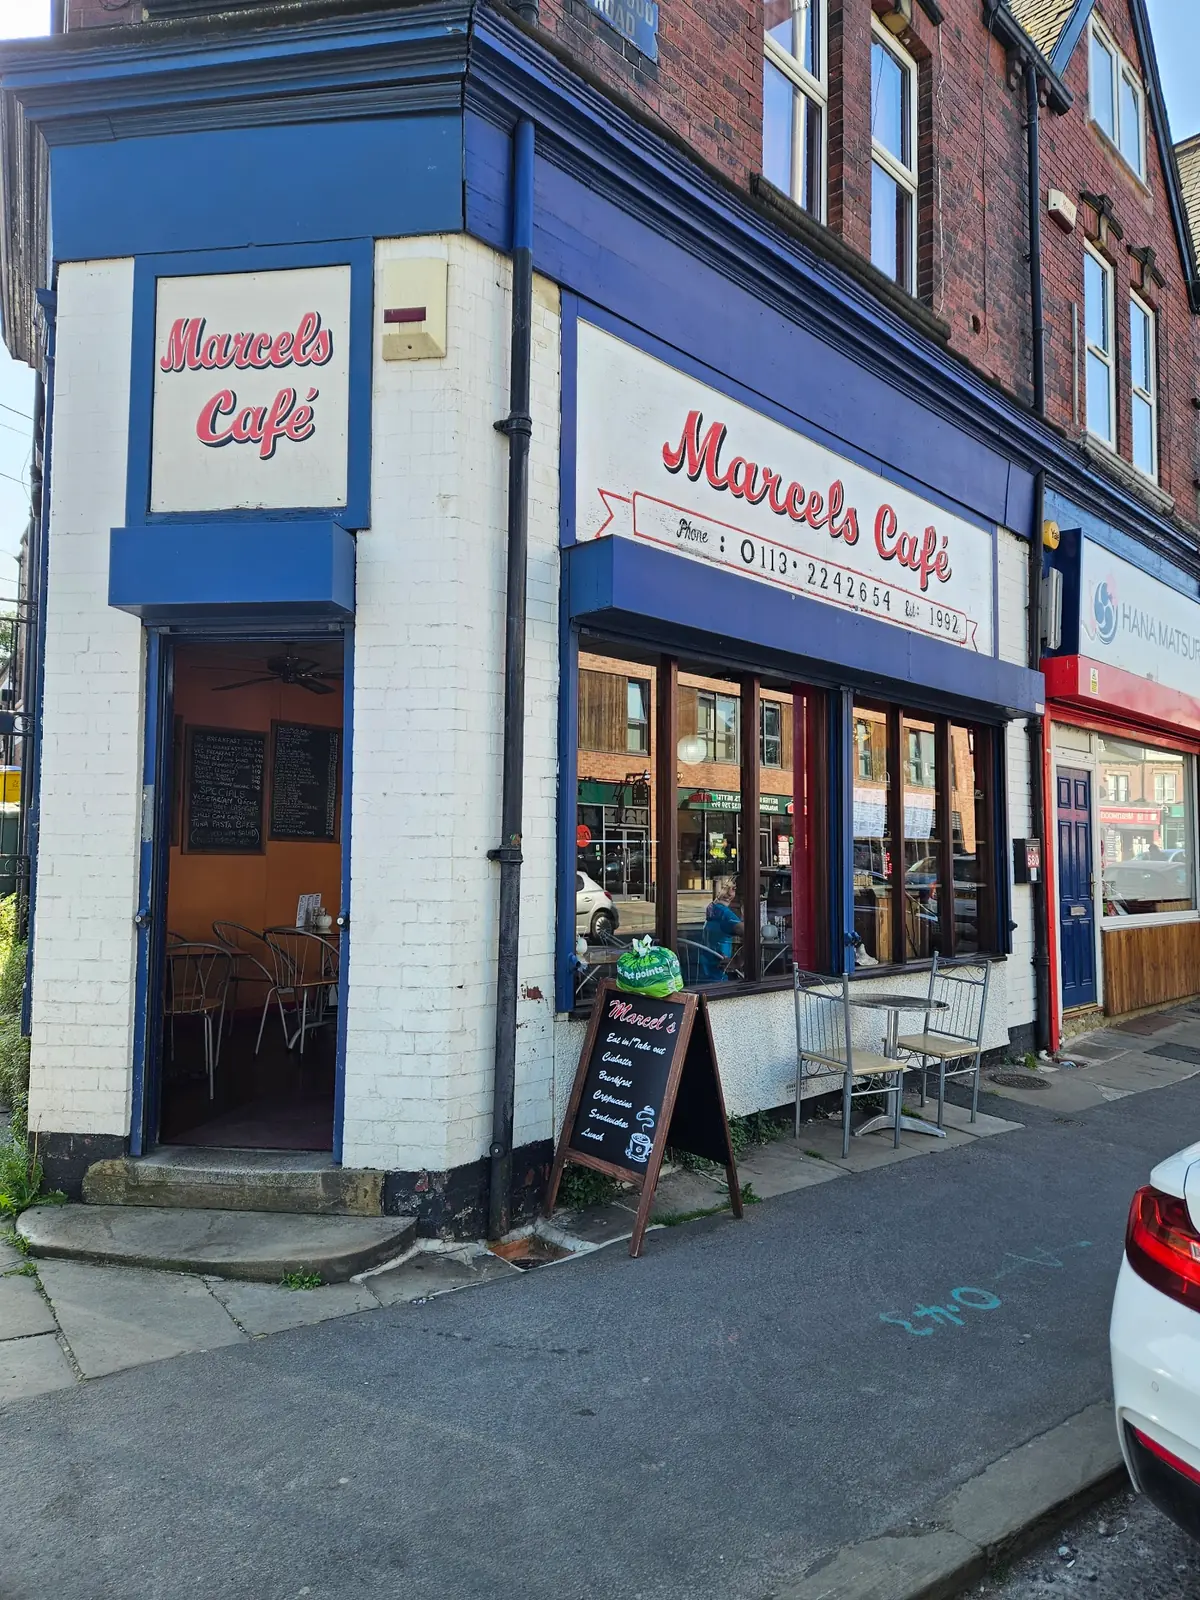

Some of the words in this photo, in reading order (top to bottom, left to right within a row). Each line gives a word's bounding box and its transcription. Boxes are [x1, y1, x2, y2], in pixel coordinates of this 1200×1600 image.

[160, 311, 333, 373] Marcels
[196, 387, 319, 460] Café
[662, 410, 859, 545] Marcels
[873, 503, 952, 591] Café
[676, 518, 709, 543] Phone
[807, 562, 891, 612] 2242654
[929, 607, 960, 634] 1992
[1122, 603, 1157, 646] HANA
[635, 965, 664, 980] points
[608, 1000, 676, 1034] Marcel's
[606, 1032, 621, 1043] Eat
[652, 1047, 667, 1055] out
[602, 1051, 632, 1067] Ciabatta
[598, 1070, 632, 1087] Breakfast
[593, 1090, 632, 1108] Cappuccino
[589, 1108, 629, 1128] Sandwiches
[581, 1128, 605, 1141] Lunch
